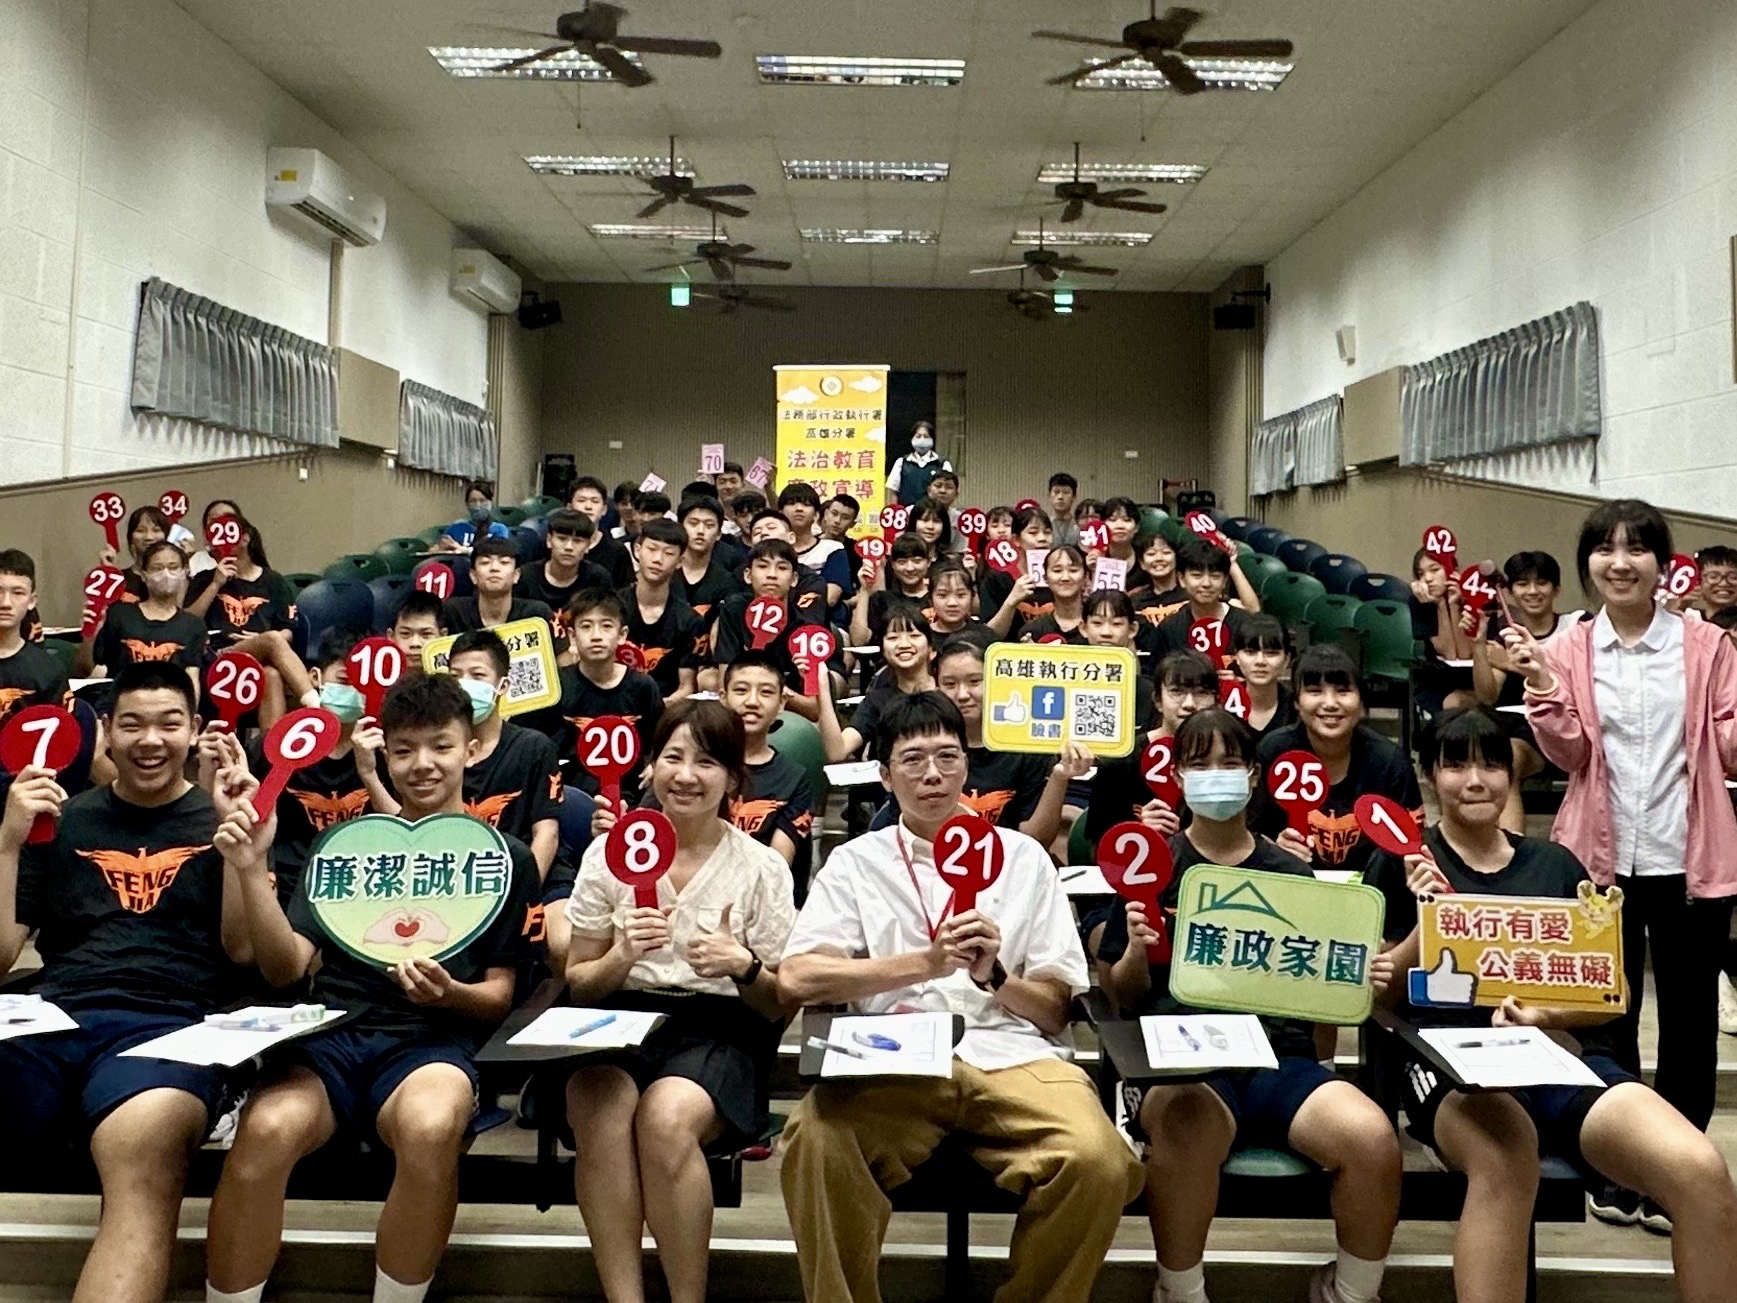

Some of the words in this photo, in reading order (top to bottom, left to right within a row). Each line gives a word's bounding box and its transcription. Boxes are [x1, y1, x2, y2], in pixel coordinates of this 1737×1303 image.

[705, 455, 721, 471] 70
[788, 450, 875, 469] 法治教育
[92, 497, 124, 521] 33
[161, 497, 187, 515] 34
[881, 507, 907, 529] 38
[210, 521, 240, 545] 29
[961, 513, 986, 533] 39
[1191, 514, 1216, 533] 40
[858, 540, 884, 556] 19
[988, 541, 1018, 567] 18
[1427, 530, 1455, 554] 42
[85, 570, 124, 598] 27
[419, 571, 448, 599] 11
[750, 602, 783, 633] 12
[793, 632, 829, 657] 16
[1192, 621, 1222, 652] 37
[351, 645, 402, 687] 10
[995, 659, 1123, 682] 高雄執行分署
[210, 660, 260, 704] 26
[22, 717, 60, 767] 7
[280, 717, 325, 759] 6
[585, 724, 635, 766] 20
[1274, 761, 1324, 802] 25
[1371, 802, 1409, 844] 1
[624, 820, 660, 873] 8
[942, 826, 995, 880] 21
[1115, 832, 1158, 885] 2
[105, 866, 177, 893] FENG
[312, 852, 507, 900] 廉潔誠信
[1440, 907, 1570, 941] 執行有愛
[1184, 923, 1367, 986] 廉政家園
[1480, 951, 1613, 985] 公義無礙
